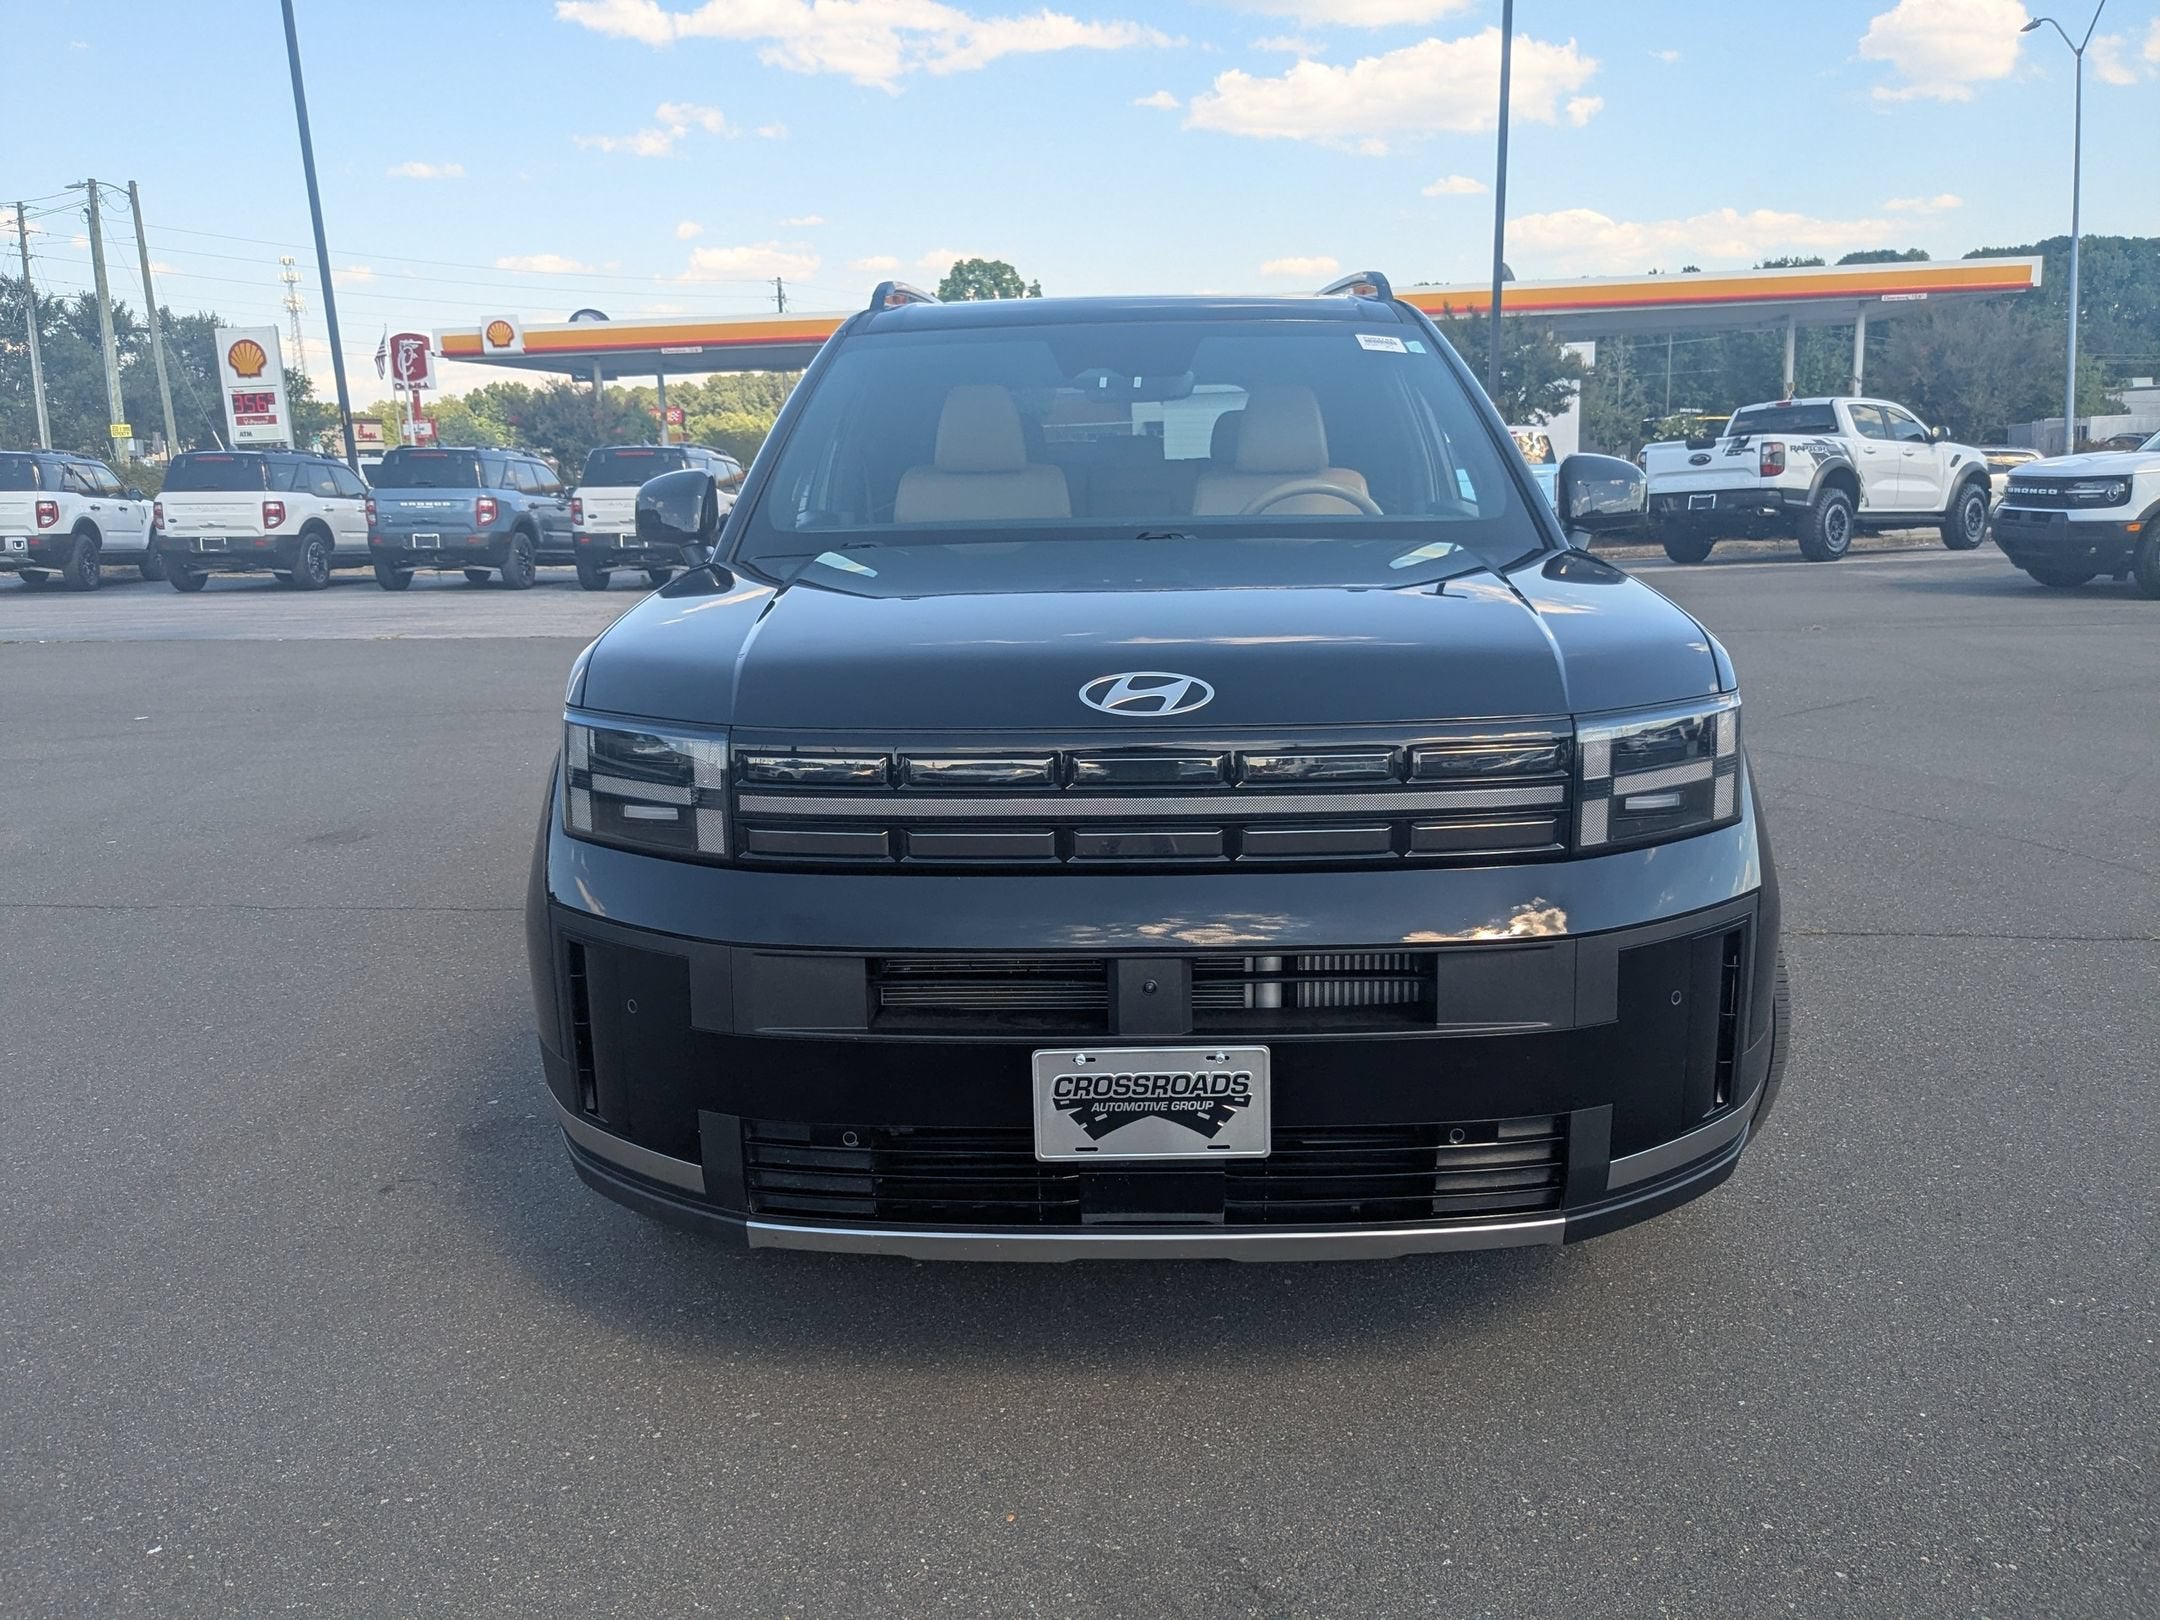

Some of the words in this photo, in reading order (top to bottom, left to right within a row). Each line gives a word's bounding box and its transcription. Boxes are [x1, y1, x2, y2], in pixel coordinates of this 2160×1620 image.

[1054, 1073, 1251, 1098] CROSSROADS
[1091, 1101, 1168, 1113] AUTOMOTIVE
[1170, 1100, 1215, 1111] GROUP
